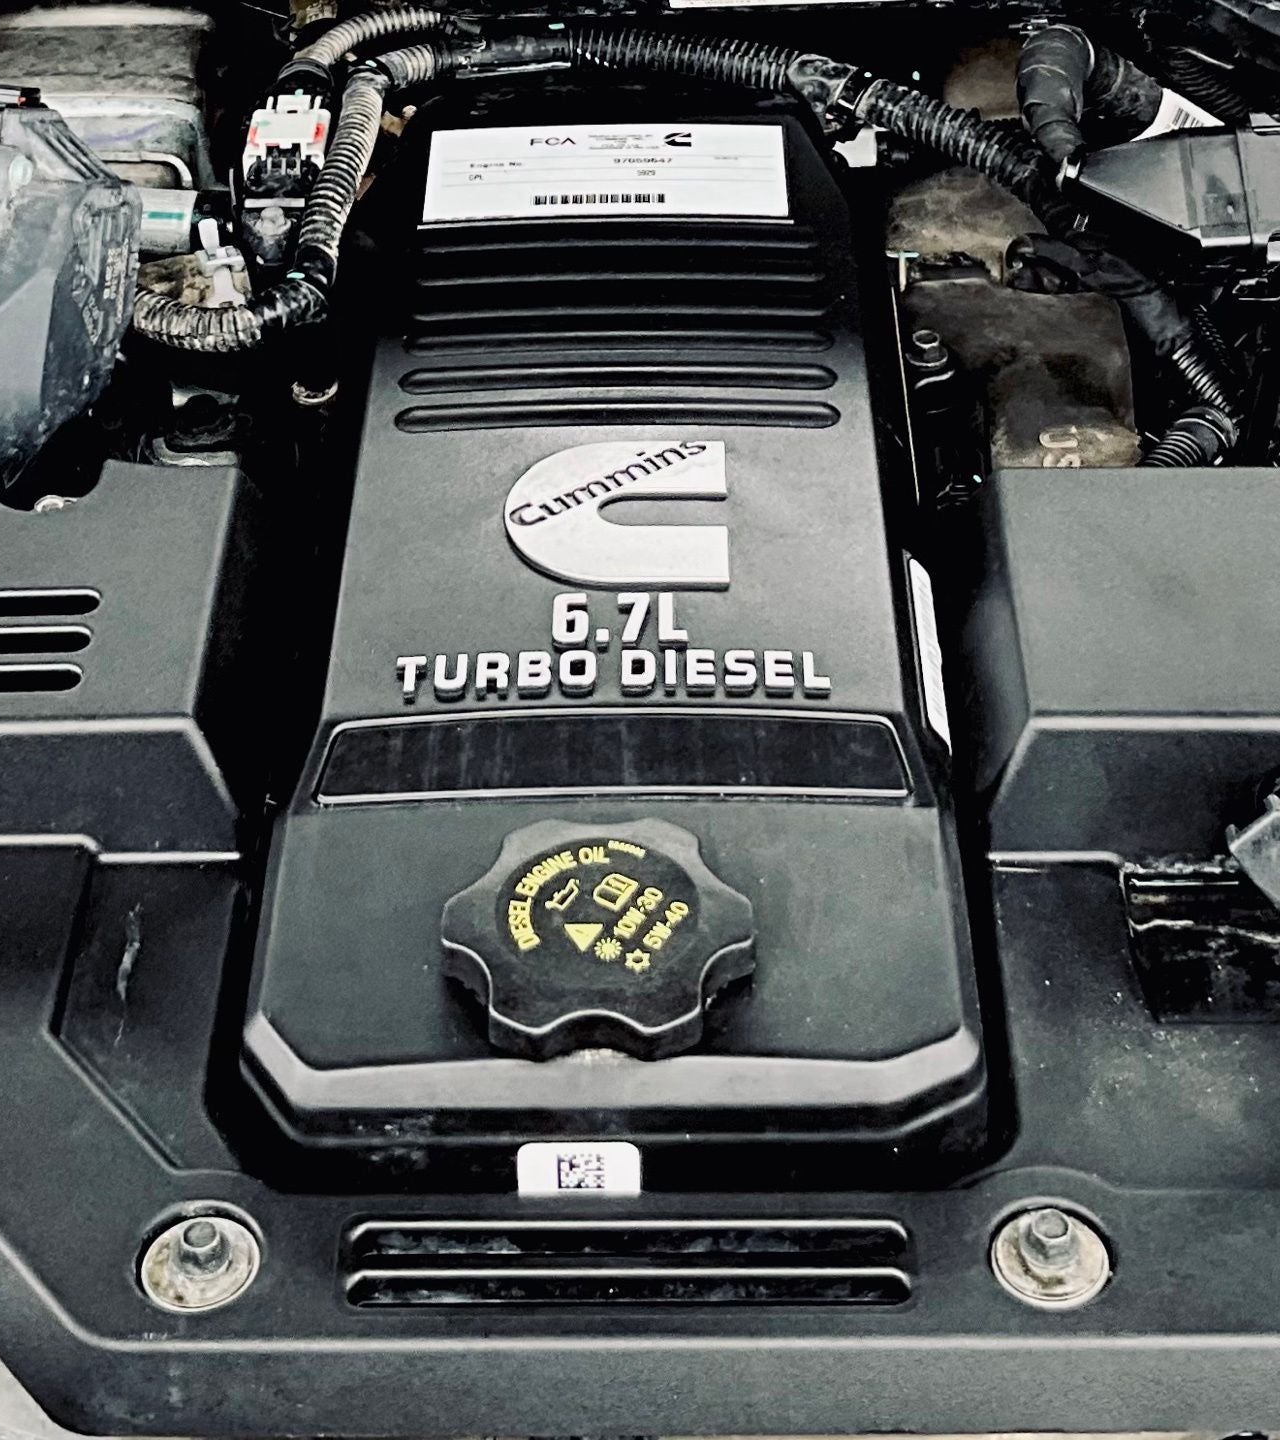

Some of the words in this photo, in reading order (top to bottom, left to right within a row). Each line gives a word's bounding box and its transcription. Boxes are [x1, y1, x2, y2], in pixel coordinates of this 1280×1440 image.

[530, 137, 576, 146] FCA
[509, 441, 707, 526] Cummins
[552, 592, 690, 648] 6.7L
[396, 650, 598, 703] TURBO
[621, 649, 831, 697] DIESEL
[515, 850, 577, 896] ENGINE
[578, 845, 610, 865] OIL
[508, 896, 541, 952] DIESEL
[642, 901, 689, 950] 5W-40
